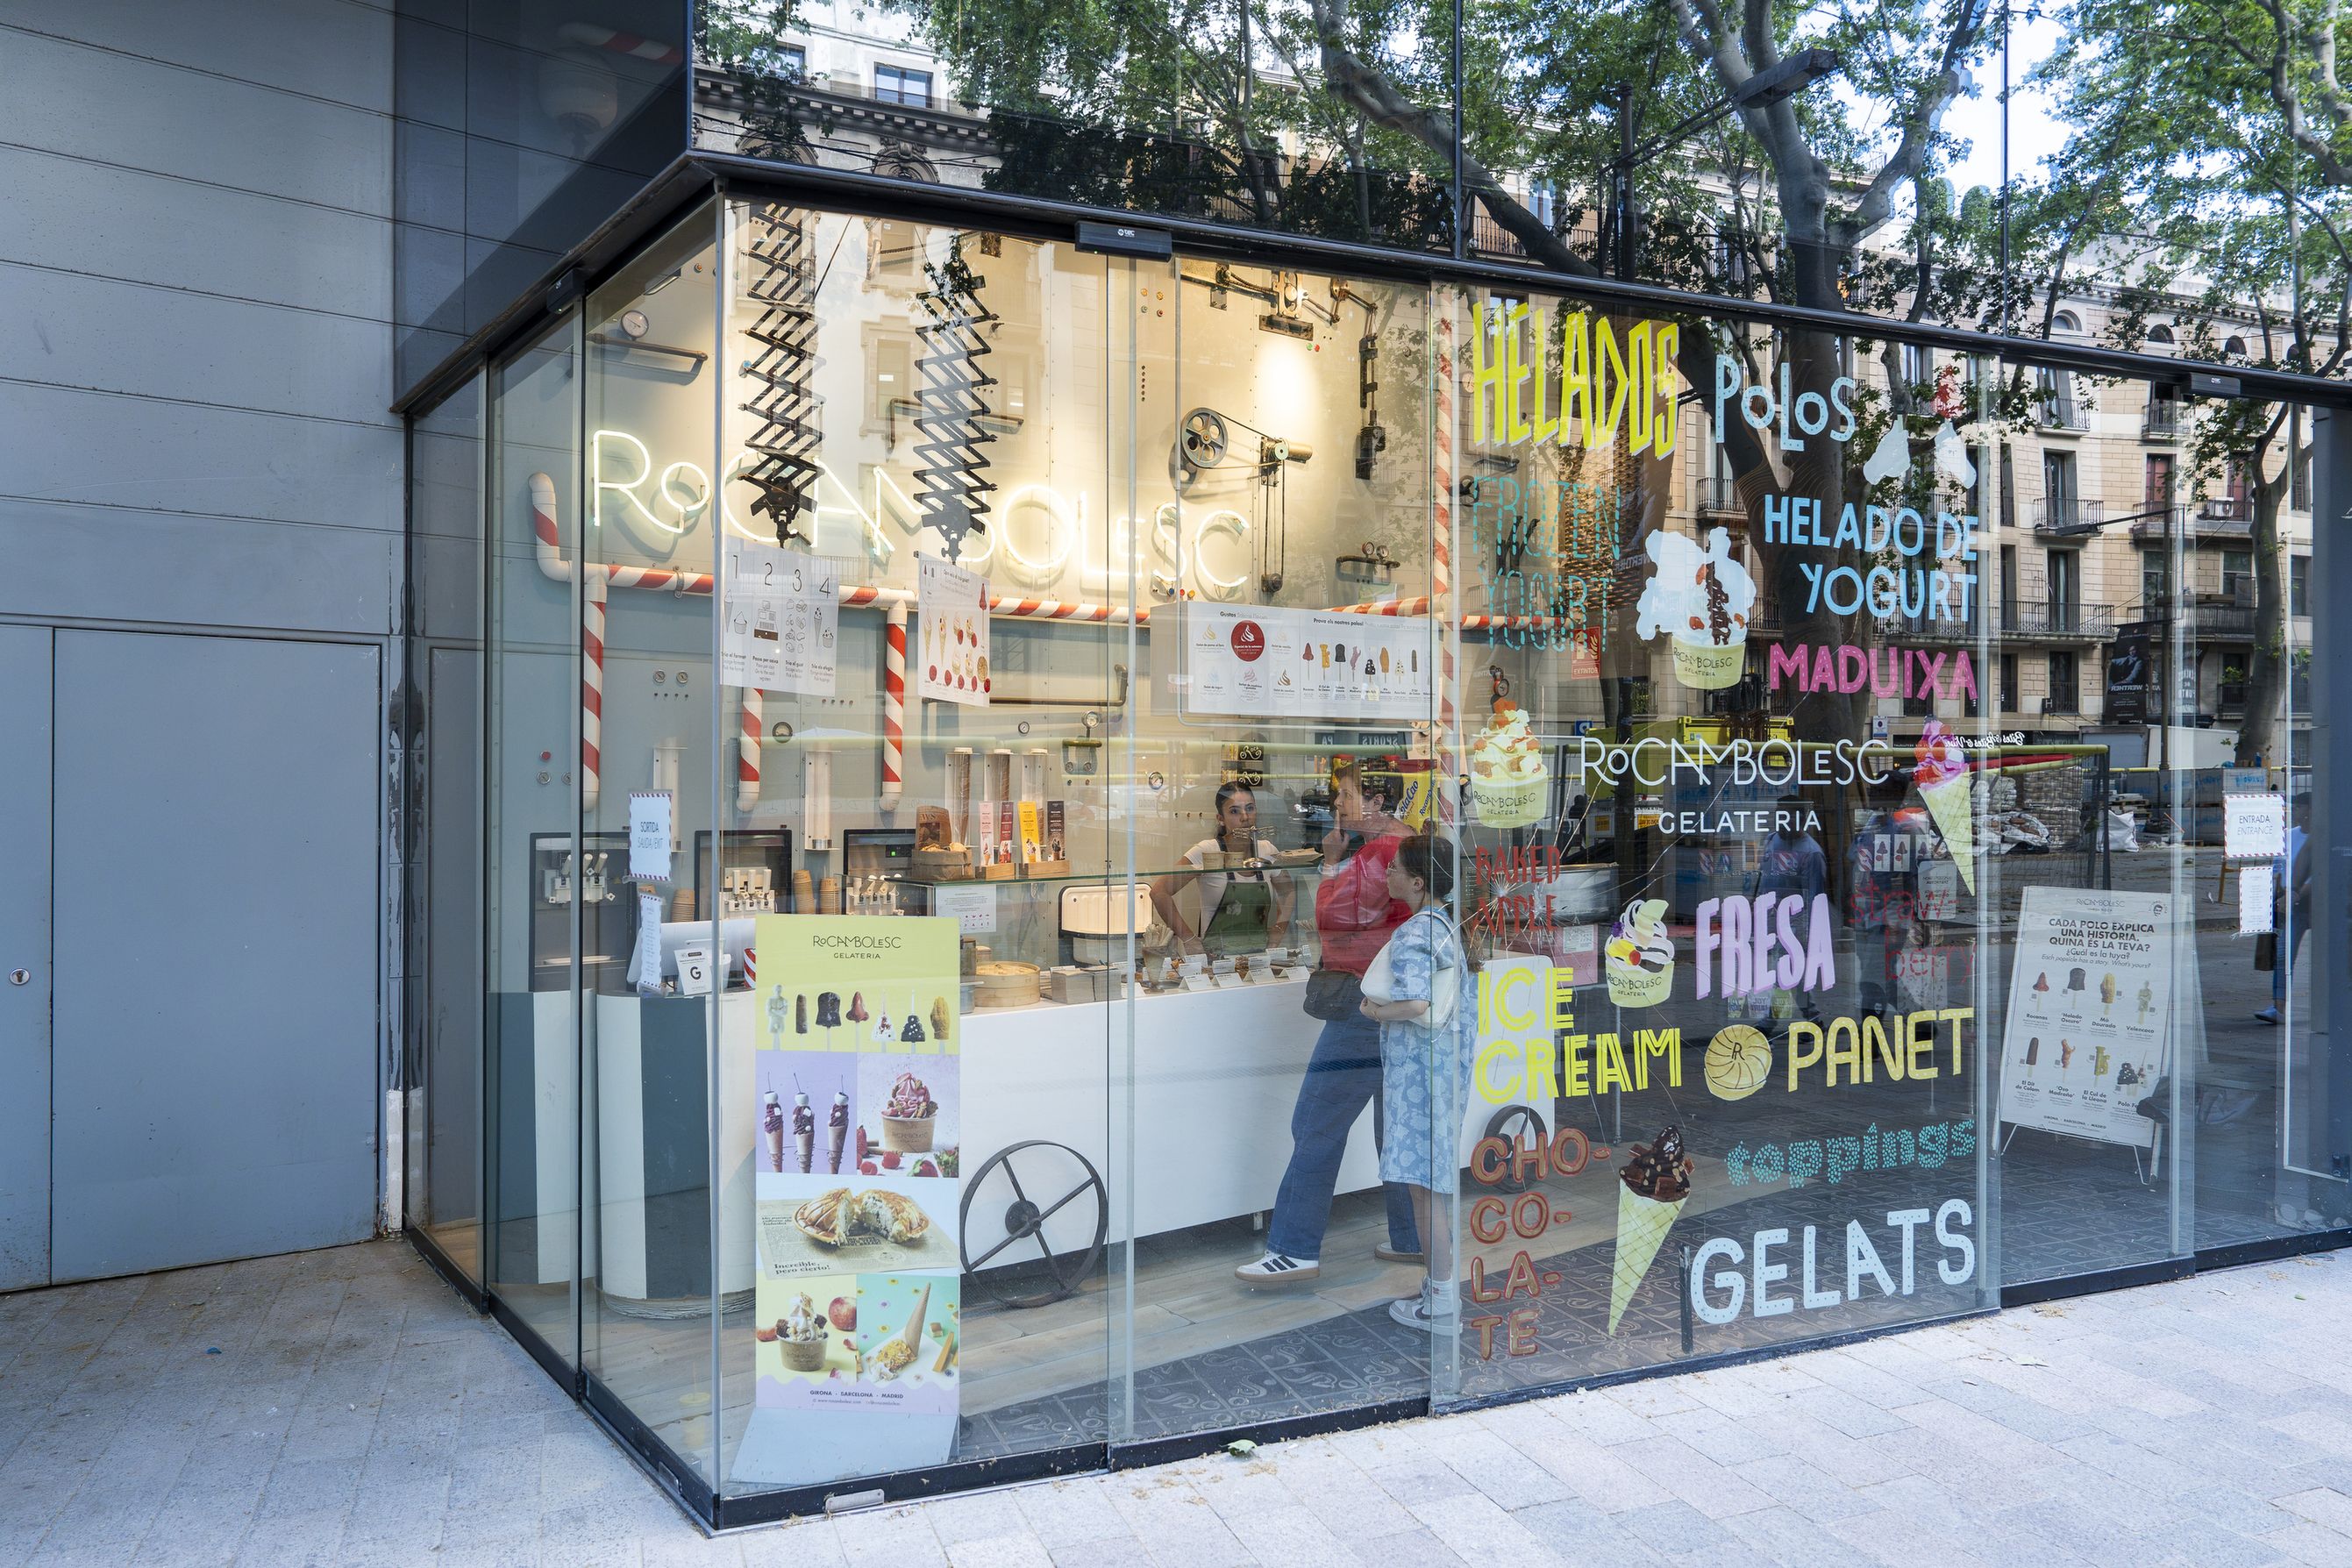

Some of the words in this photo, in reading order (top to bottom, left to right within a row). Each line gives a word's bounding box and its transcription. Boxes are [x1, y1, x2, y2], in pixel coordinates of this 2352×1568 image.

[1472, 302, 1679, 460] HELADOS
[1472, 474, 1622, 563] FROZEN
[1764, 493, 1924, 559] HELADO
[1935, 515, 1978, 561] DE
[765, 562, 773, 587] 2
[793, 568, 802, 592] 3
[819, 577, 831, 599] 4
[1479, 564, 1617, 653] YOGURT
[1798, 562, 1978, 623] YOGURT
[1768, 642, 1978, 701] MADUIXA
[640, 821, 659, 833] SORTIDA
[1658, 809, 1821, 835] GELATERIA
[2237, 825, 2273, 836] ENTRANCE
[2239, 814, 2271, 824] ENTRADA
[1695, 891, 1835, 1001] FRESA
[2049, 918, 2078, 928] CADA
[2079, 920, 2109, 930] POLO
[2112, 922, 2155, 933] EXPLICA
[2049, 937, 2085, 947] QUINA
[2087, 937, 2099, 948] ÉS
[2102, 940, 2114, 950] LA
[2118, 942, 2151, 952] TEVA?
[2061, 929, 2085, 937] UNA
[2066, 947, 2087, 957] ¿Cuál
[2101, 950, 2107, 959] la
[2109, 951, 2131, 961] tuya?
[690, 966, 702, 980] G
[1476, 966, 1575, 1037] ICE
[1473, 1027, 1682, 1105] CREAM
[1786, 1007, 1975, 1093] PANET
[1470, 1126, 1613, 1186] CHO-
[1723, 1118, 1977, 1189] toppings
[1470, 1188, 1572, 1246] CO-
[1471, 1249, 1563, 1304] LA-
[1690, 1198, 1976, 1325] GELATS
[1472, 1308, 1540, 1361] TE
